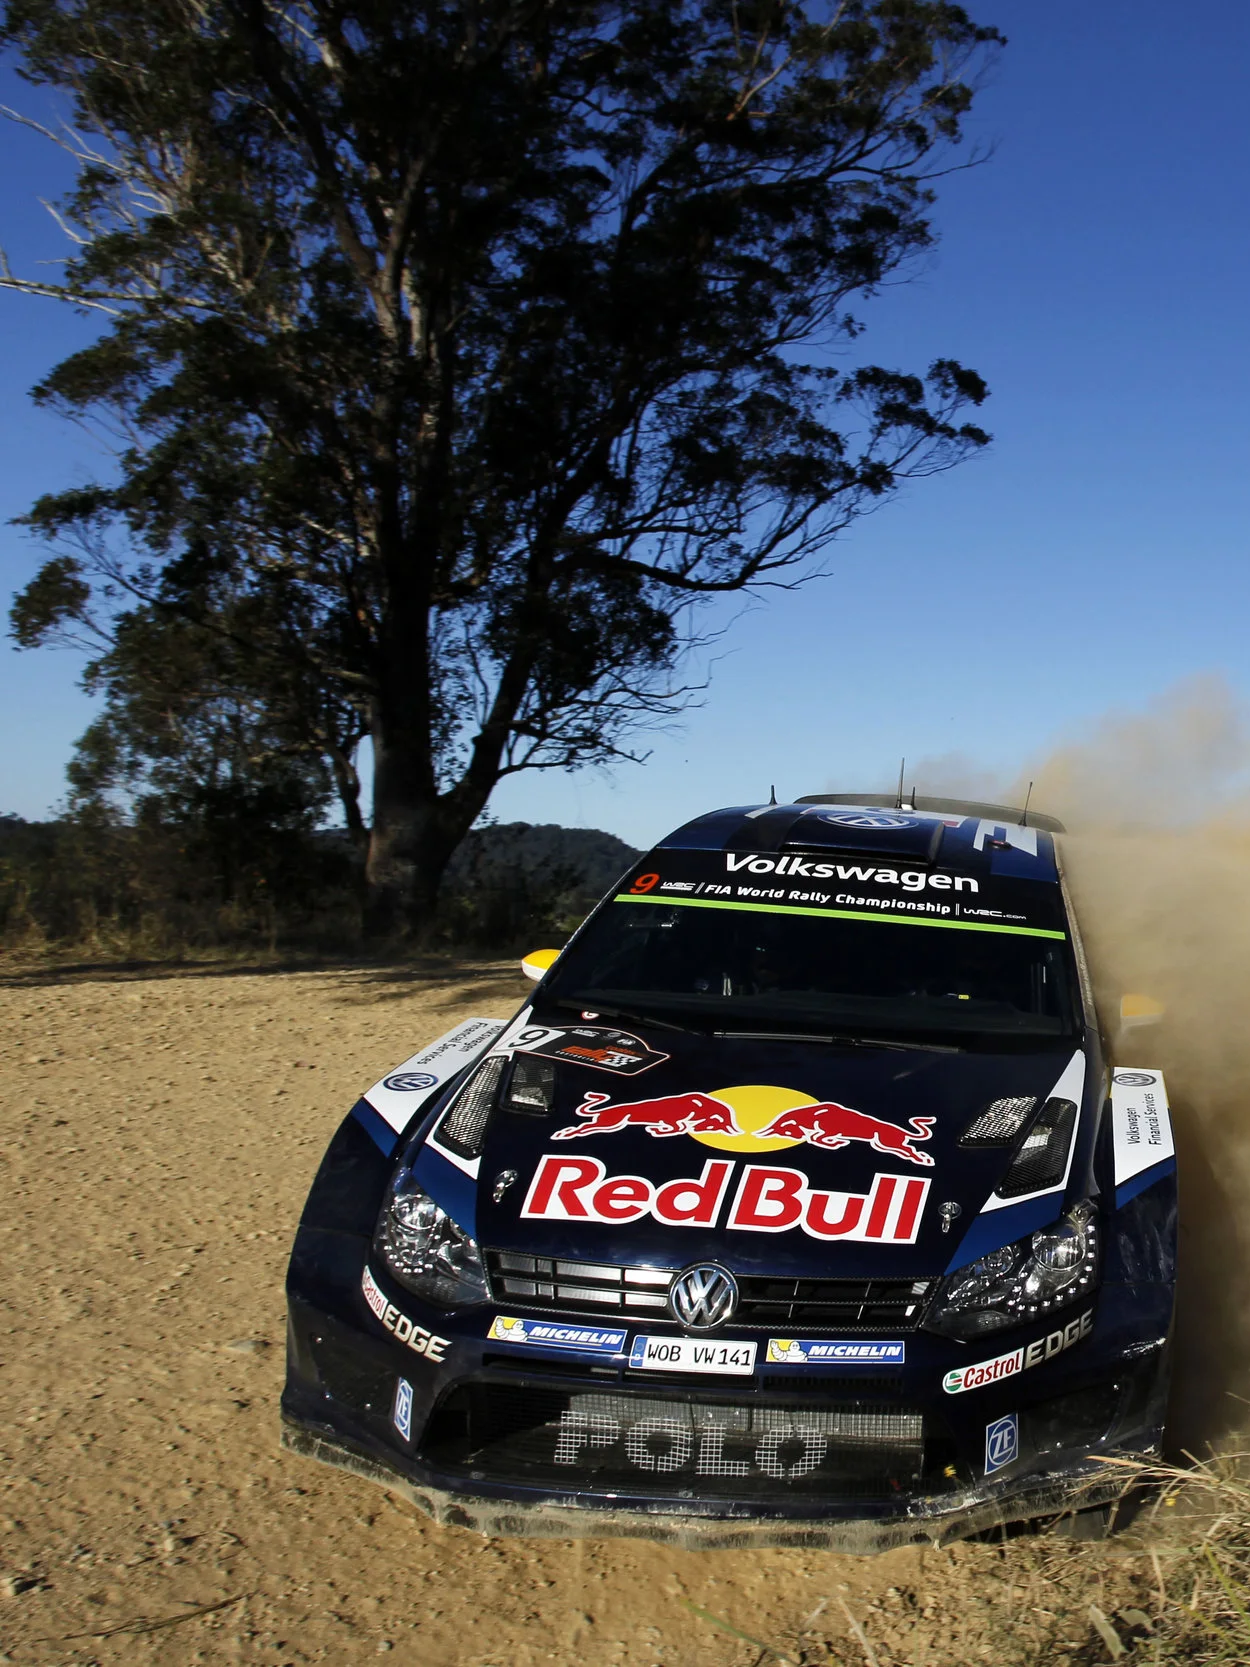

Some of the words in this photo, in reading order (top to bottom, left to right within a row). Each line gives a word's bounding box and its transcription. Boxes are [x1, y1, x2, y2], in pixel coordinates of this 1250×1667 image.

[725, 853, 979, 893] Volkswagen
[630, 873, 659, 894] 9
[704, 884, 731, 895] FIA
[737, 886, 785, 898] World
[788, 890, 830, 903] Rally
[835, 894, 950, 915] Championship
[508, 1029, 550, 1048] 9
[1142, 1093, 1158, 1115] Services
[1126, 1107, 1141, 1145] Volkswagen
[1145, 1116, 1162, 1145] Financial
[520, 1155, 736, 1228] Red
[725, 1164, 932, 1244] Bull
[382, 1304, 453, 1363] EDGE
[528, 1325, 623, 1346] MICHELIN
[807, 1344, 902, 1358] MICHELIN
[963, 1351, 1021, 1389] Castrol
[1024, 1307, 1094, 1370] EDGE
[647, 1343, 682, 1362] WOB
[554, 1410, 828, 1479] POLO
[991, 1423, 1014, 1460] ZF
